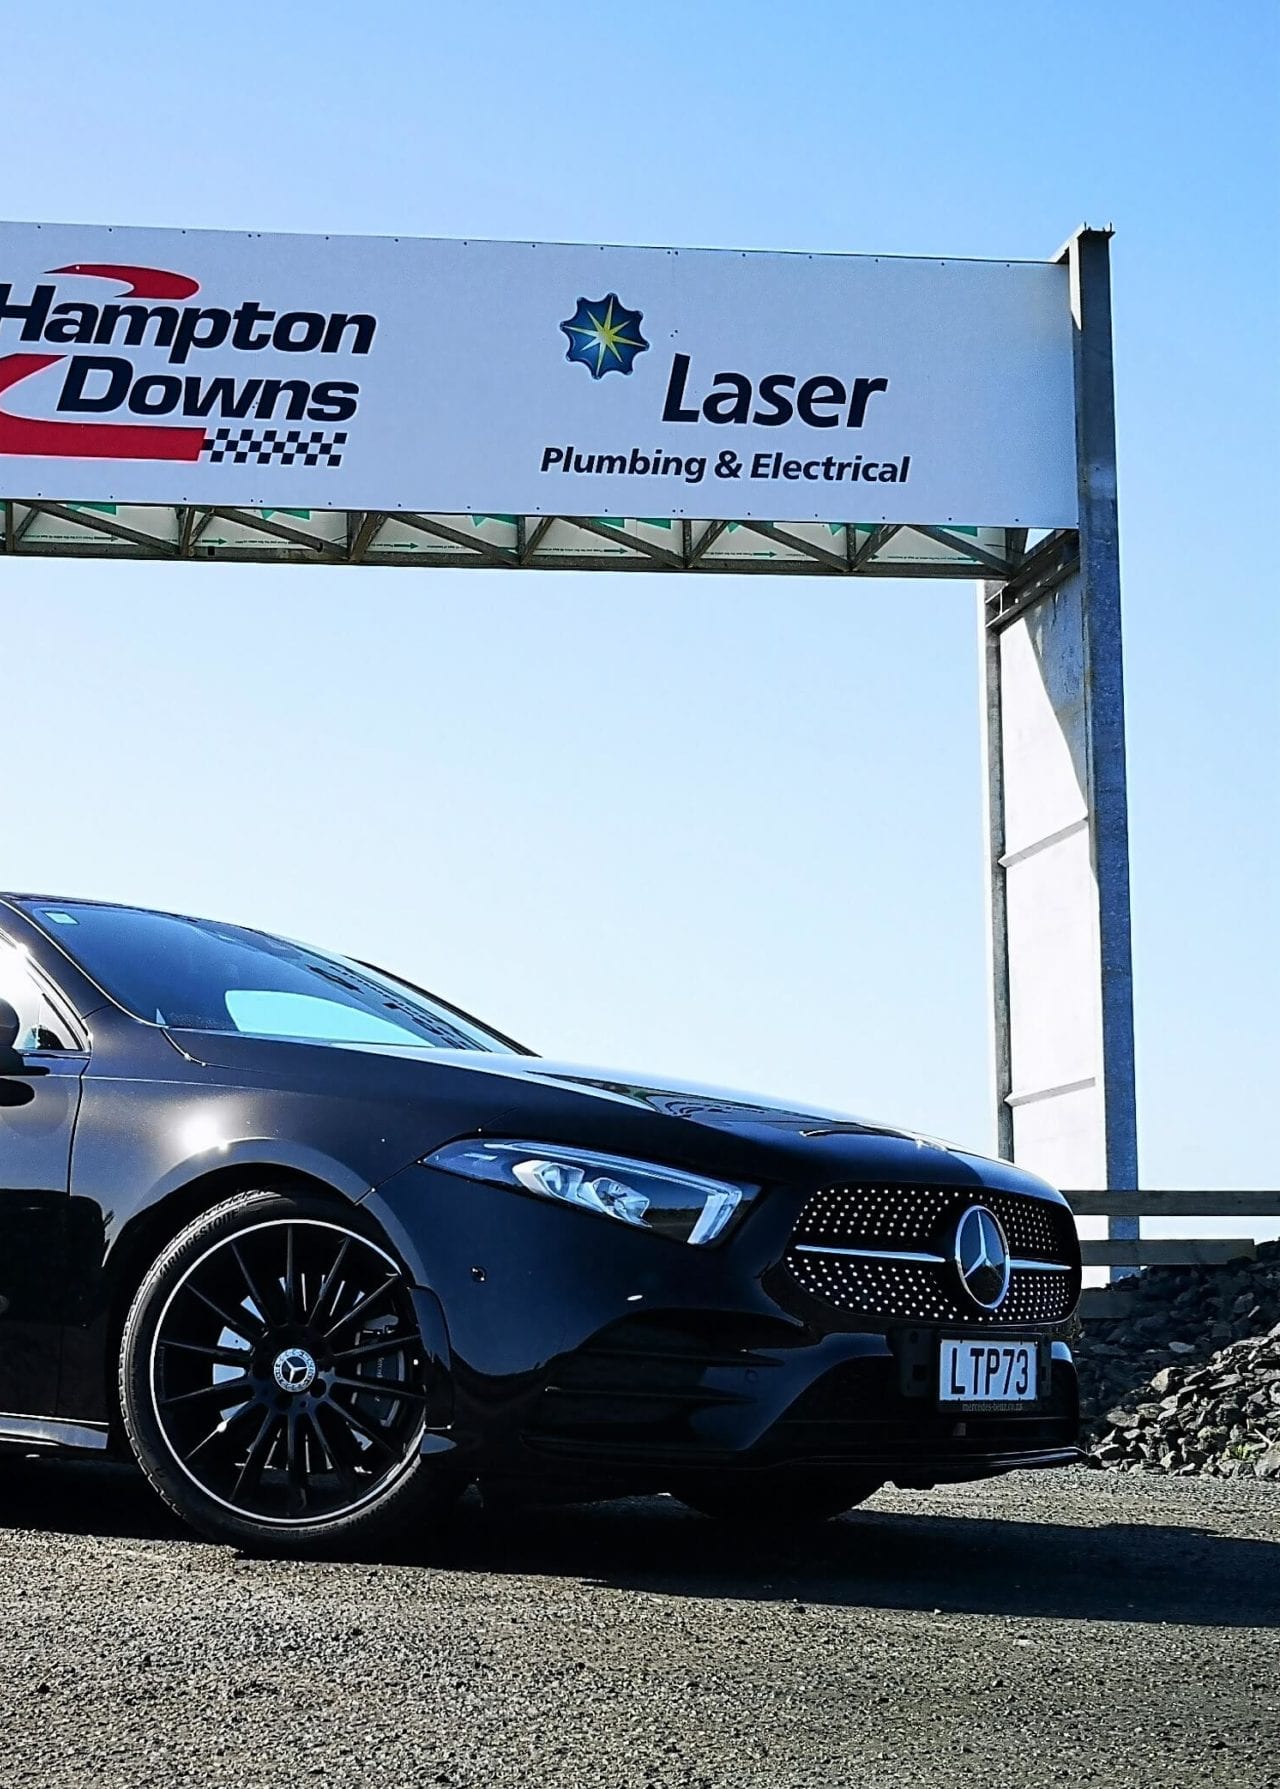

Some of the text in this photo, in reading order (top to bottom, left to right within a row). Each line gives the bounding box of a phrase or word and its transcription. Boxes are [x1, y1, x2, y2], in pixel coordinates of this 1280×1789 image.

[56, 355, 360, 422] Downs
[662, 352, 889, 428] Laser
[540, 446, 911, 484] Plumbing & Electrical
[950, 1347, 1029, 1396] LTP73
